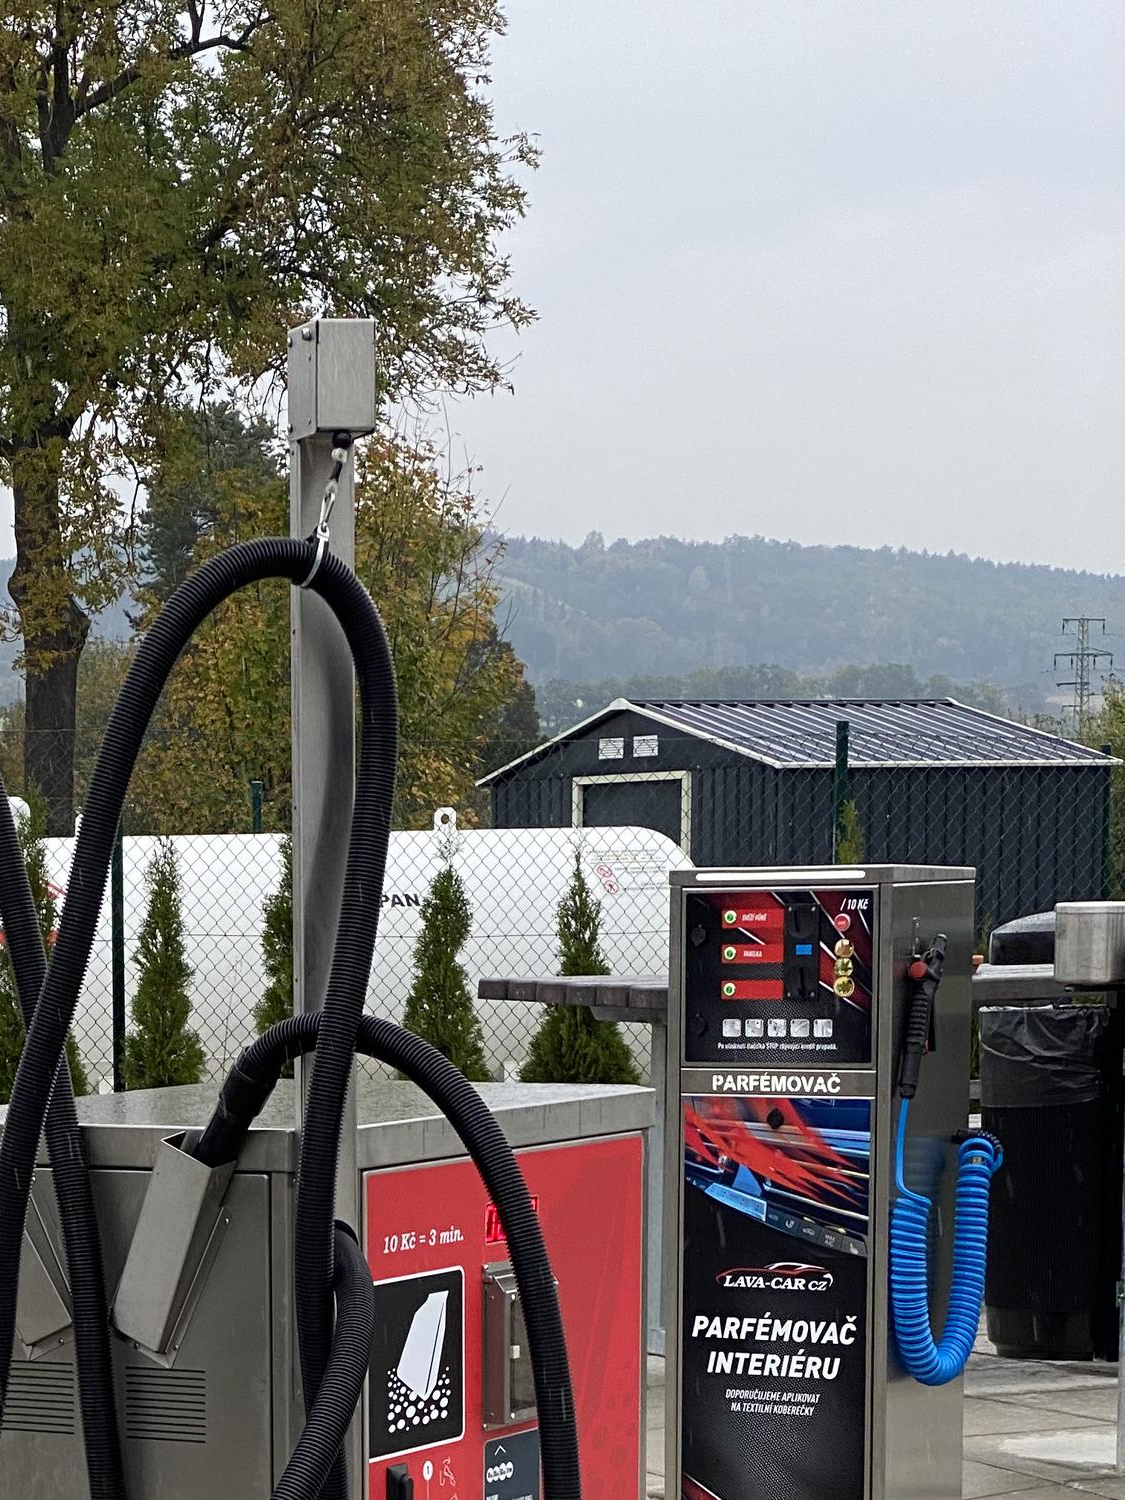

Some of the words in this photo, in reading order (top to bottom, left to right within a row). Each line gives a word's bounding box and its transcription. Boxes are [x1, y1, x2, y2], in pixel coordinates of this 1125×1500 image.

[379, 893, 421, 908] PAN
[847, 898, 857, 910] 10
[857, 898, 869, 910] Kč
[712, 1072, 841, 1094] PARFÉMOVAČ
[383, 1234, 398, 1254] 10
[400, 1231, 416, 1251] Kč
[429, 1229, 437, 1246] 3
[439, 1225, 464, 1245] min.
[723, 1275, 806, 1291] LAVA-CAR
[807, 1280, 828, 1292] CZ
[691, 1311, 857, 1346] PARFÉMOVAČ
[706, 1348, 841, 1380] INTERIÉRU
[725, 1388, 782, 1402] DOPORUČUJEME
[782, 1392, 821, 1404] APLIKOVAT
[730, 1402, 742, 1412] NA
[742, 1402, 774, 1414] TEXTILNÍ
[773, 1405, 815, 1417] KOBEREČKY
